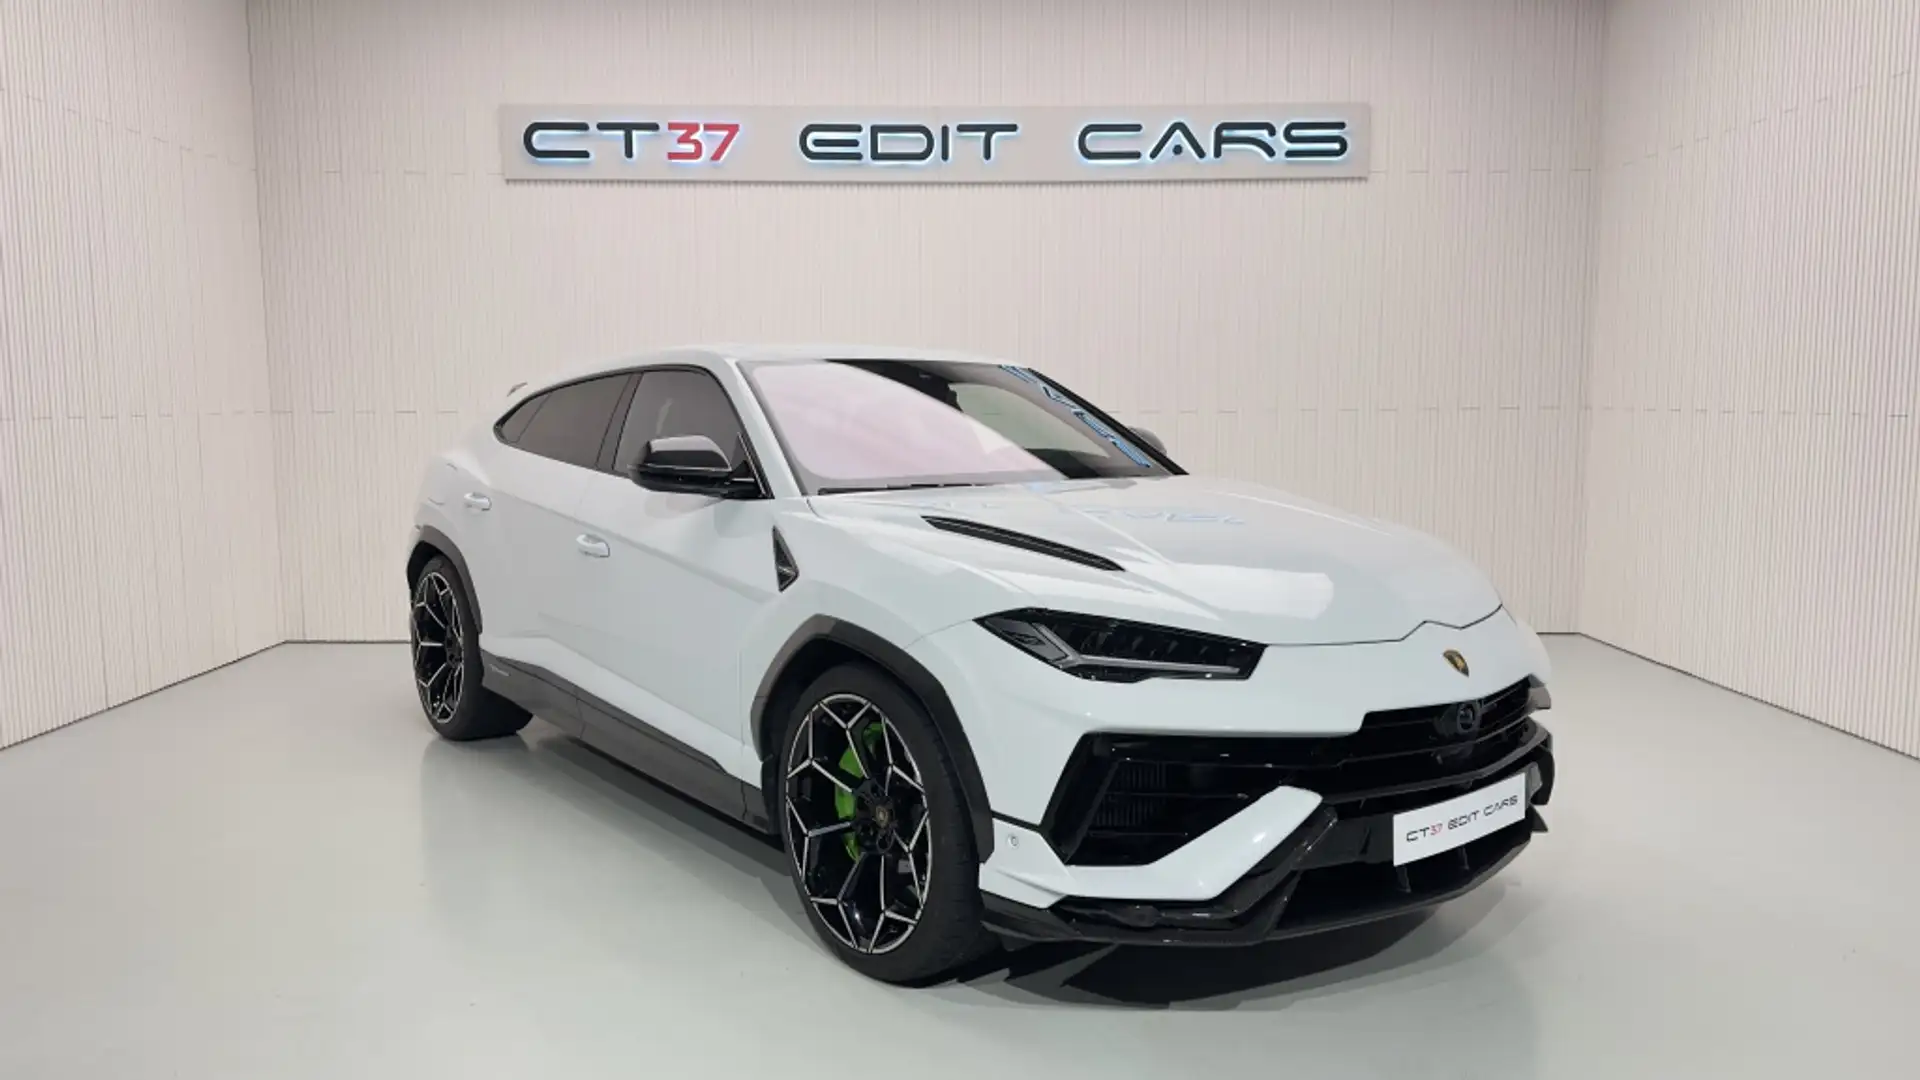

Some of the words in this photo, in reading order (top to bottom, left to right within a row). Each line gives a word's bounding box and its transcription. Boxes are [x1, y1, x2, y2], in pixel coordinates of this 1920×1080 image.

[523, 122, 740, 161] CT37
[799, 123, 1018, 161] EDIT
[1077, 122, 1348, 160] CARS
[1406, 823, 1443, 842] CT37
[1448, 810, 1480, 830] EDIT
[1483, 795, 1518, 816] CARS
